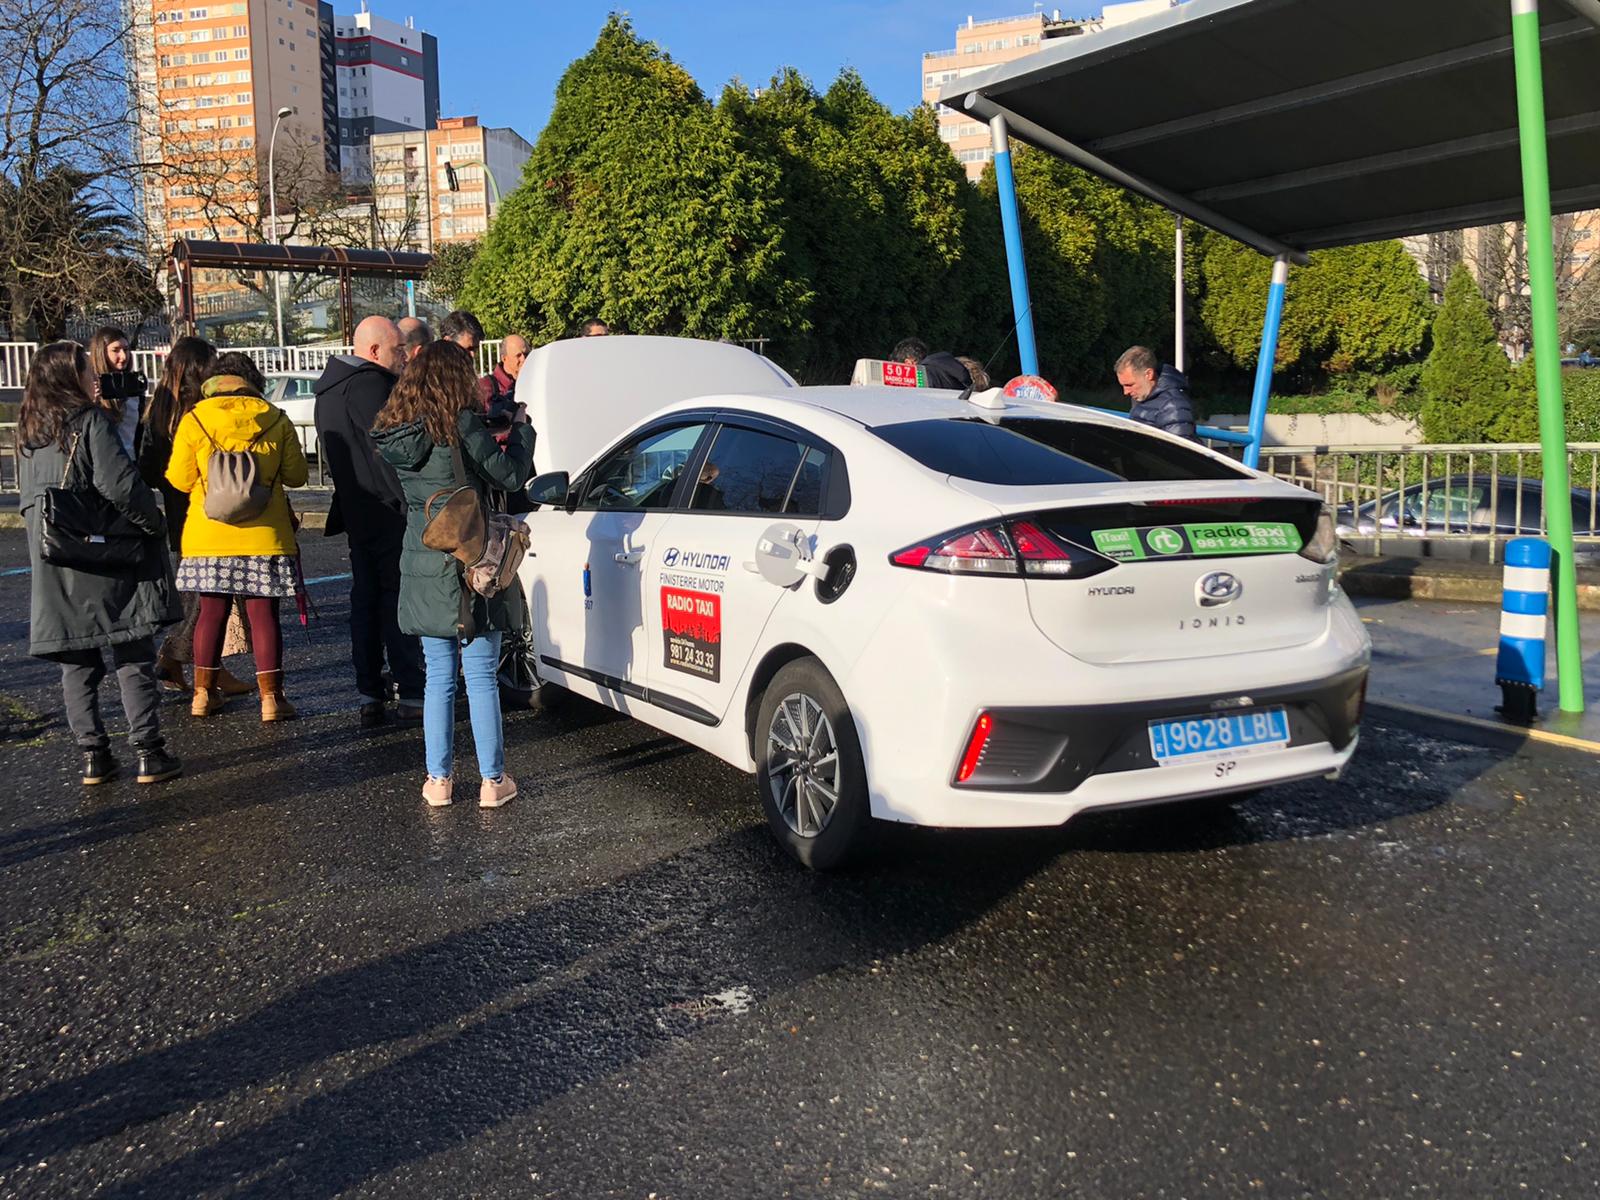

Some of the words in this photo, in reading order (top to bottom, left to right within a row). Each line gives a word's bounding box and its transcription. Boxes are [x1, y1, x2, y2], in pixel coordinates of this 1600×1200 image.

[886, 364, 911, 377] 507
[1191, 524, 1286, 538] radioTaxi
[1196, 538, 1225, 548] 981
[1229, 538, 1248, 547] 24
[1250, 537, 1268, 546] 33
[1271, 537, 1288, 546] 33
[681, 552, 731, 571] HYUNDAI
[660, 573, 697, 589] FINISTERRE
[698, 577, 725, 593] MOTOR
[1088, 586, 1135, 596] HYUNDAI
[667, 594, 694, 613] RADIO
[695, 598, 714, 617] TAXI
[670, 644, 683, 659] 981
[684, 647, 694, 662] 24
[695, 649, 704, 666] 33
[705, 652, 714, 669] 33
[1169, 717, 1233, 752] 9628
[1238, 713, 1282, 743] LBL
[1214, 761, 1237, 778] SP
